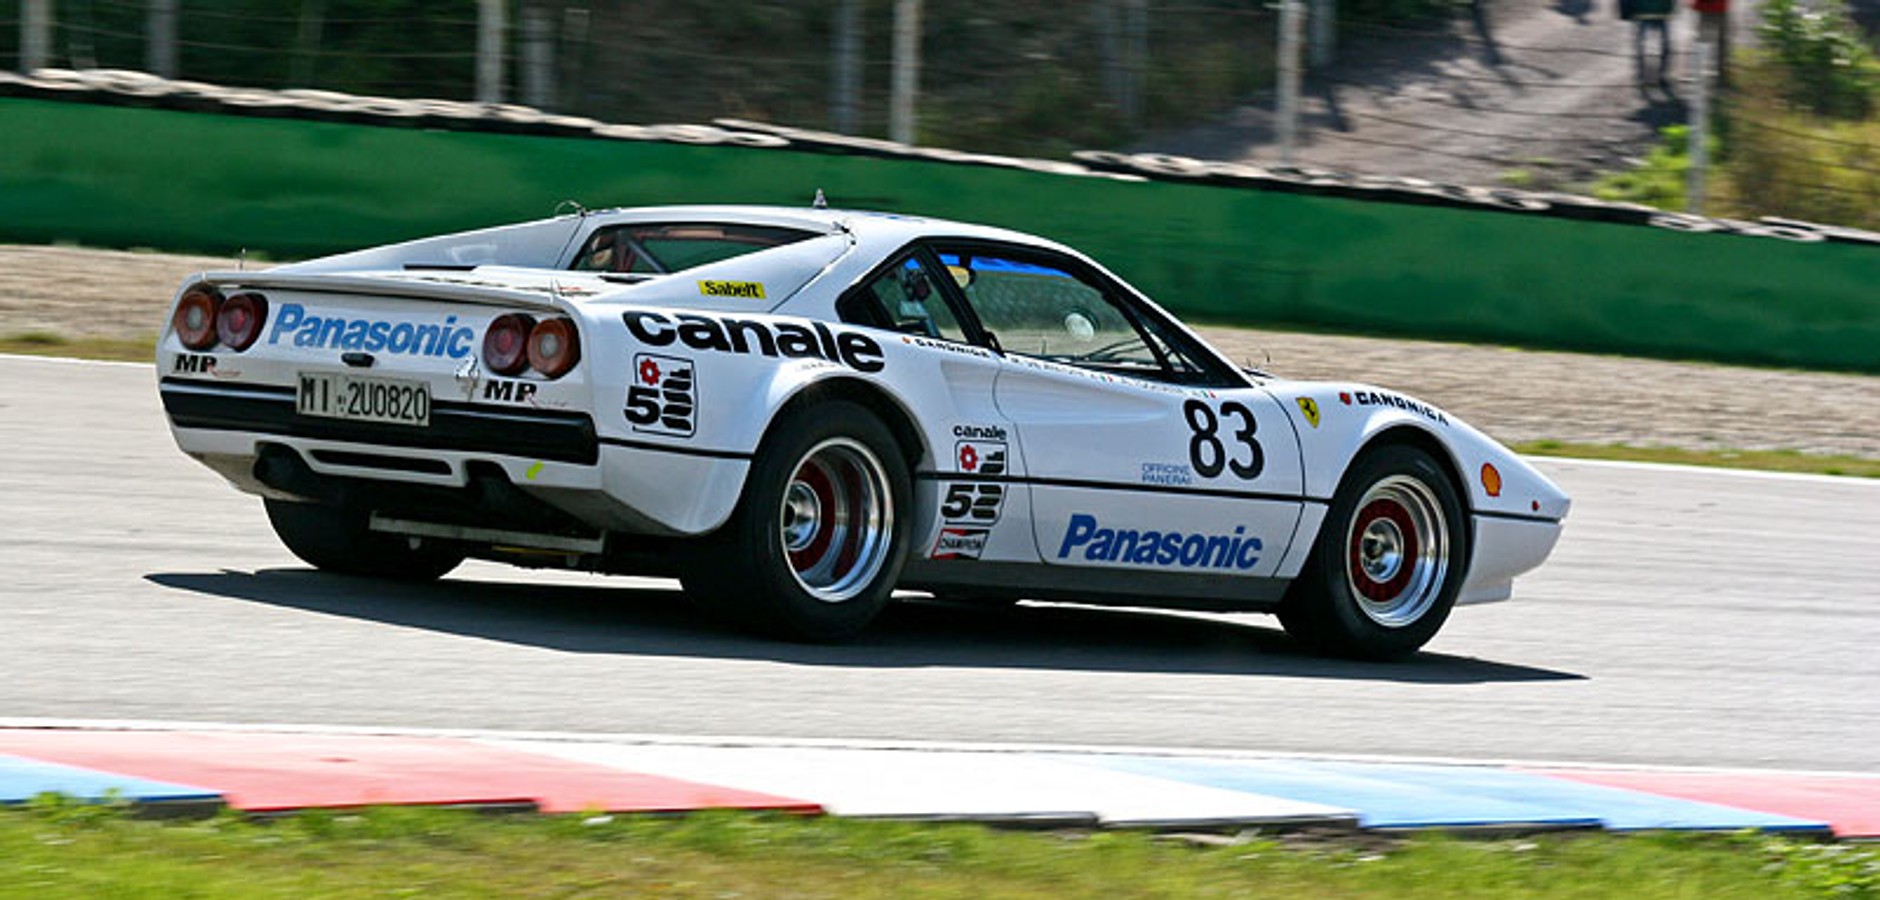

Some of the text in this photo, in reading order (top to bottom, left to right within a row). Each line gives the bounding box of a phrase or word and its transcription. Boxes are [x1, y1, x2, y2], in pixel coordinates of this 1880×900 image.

[704, 280, 761, 298] Sabelt
[269, 303, 474, 359] Panasonic
[622, 311, 886, 373] canale
[300, 376, 328, 411] MI
[953, 424, 1008, 440] canale
[1183, 399, 1264, 480] 83
[1058, 512, 1263, 570] Panasonic
